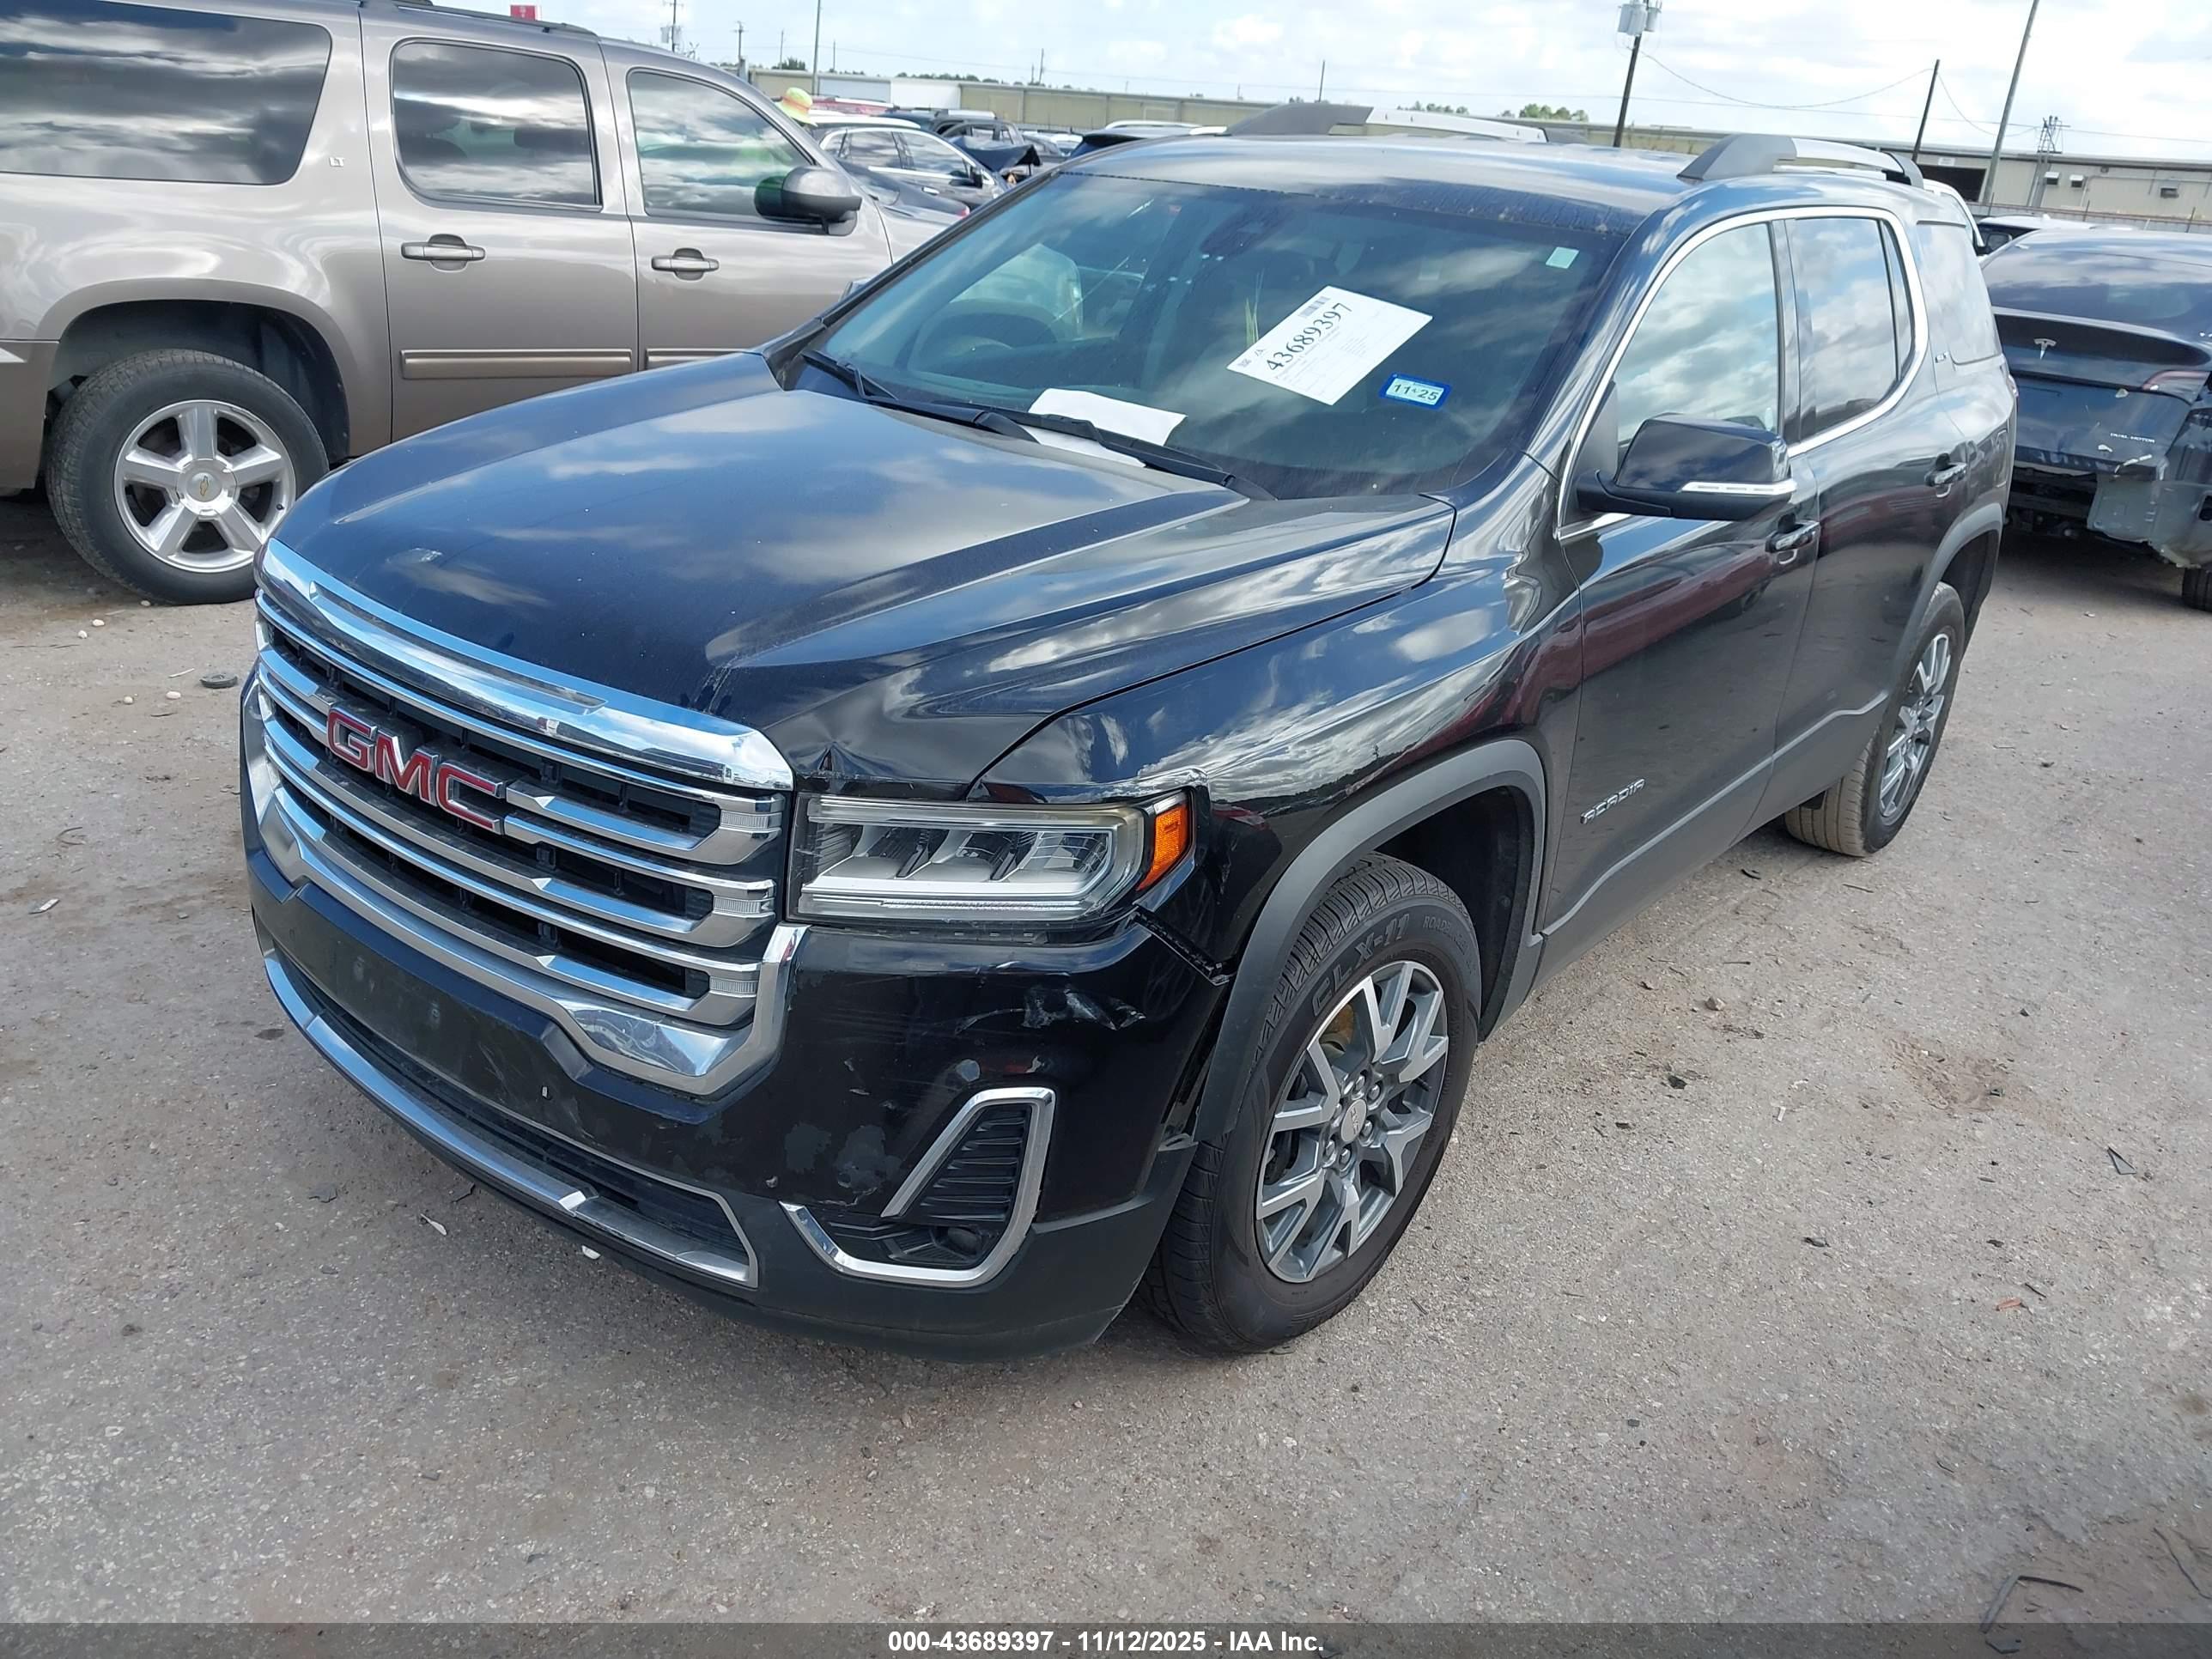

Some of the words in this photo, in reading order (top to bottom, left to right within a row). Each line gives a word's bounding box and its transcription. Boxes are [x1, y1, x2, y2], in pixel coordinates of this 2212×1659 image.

[1267, 301, 1352, 371] 43689397
[327, 707, 504, 836] GMC
[1580, 778, 1645, 824] ACADIA
